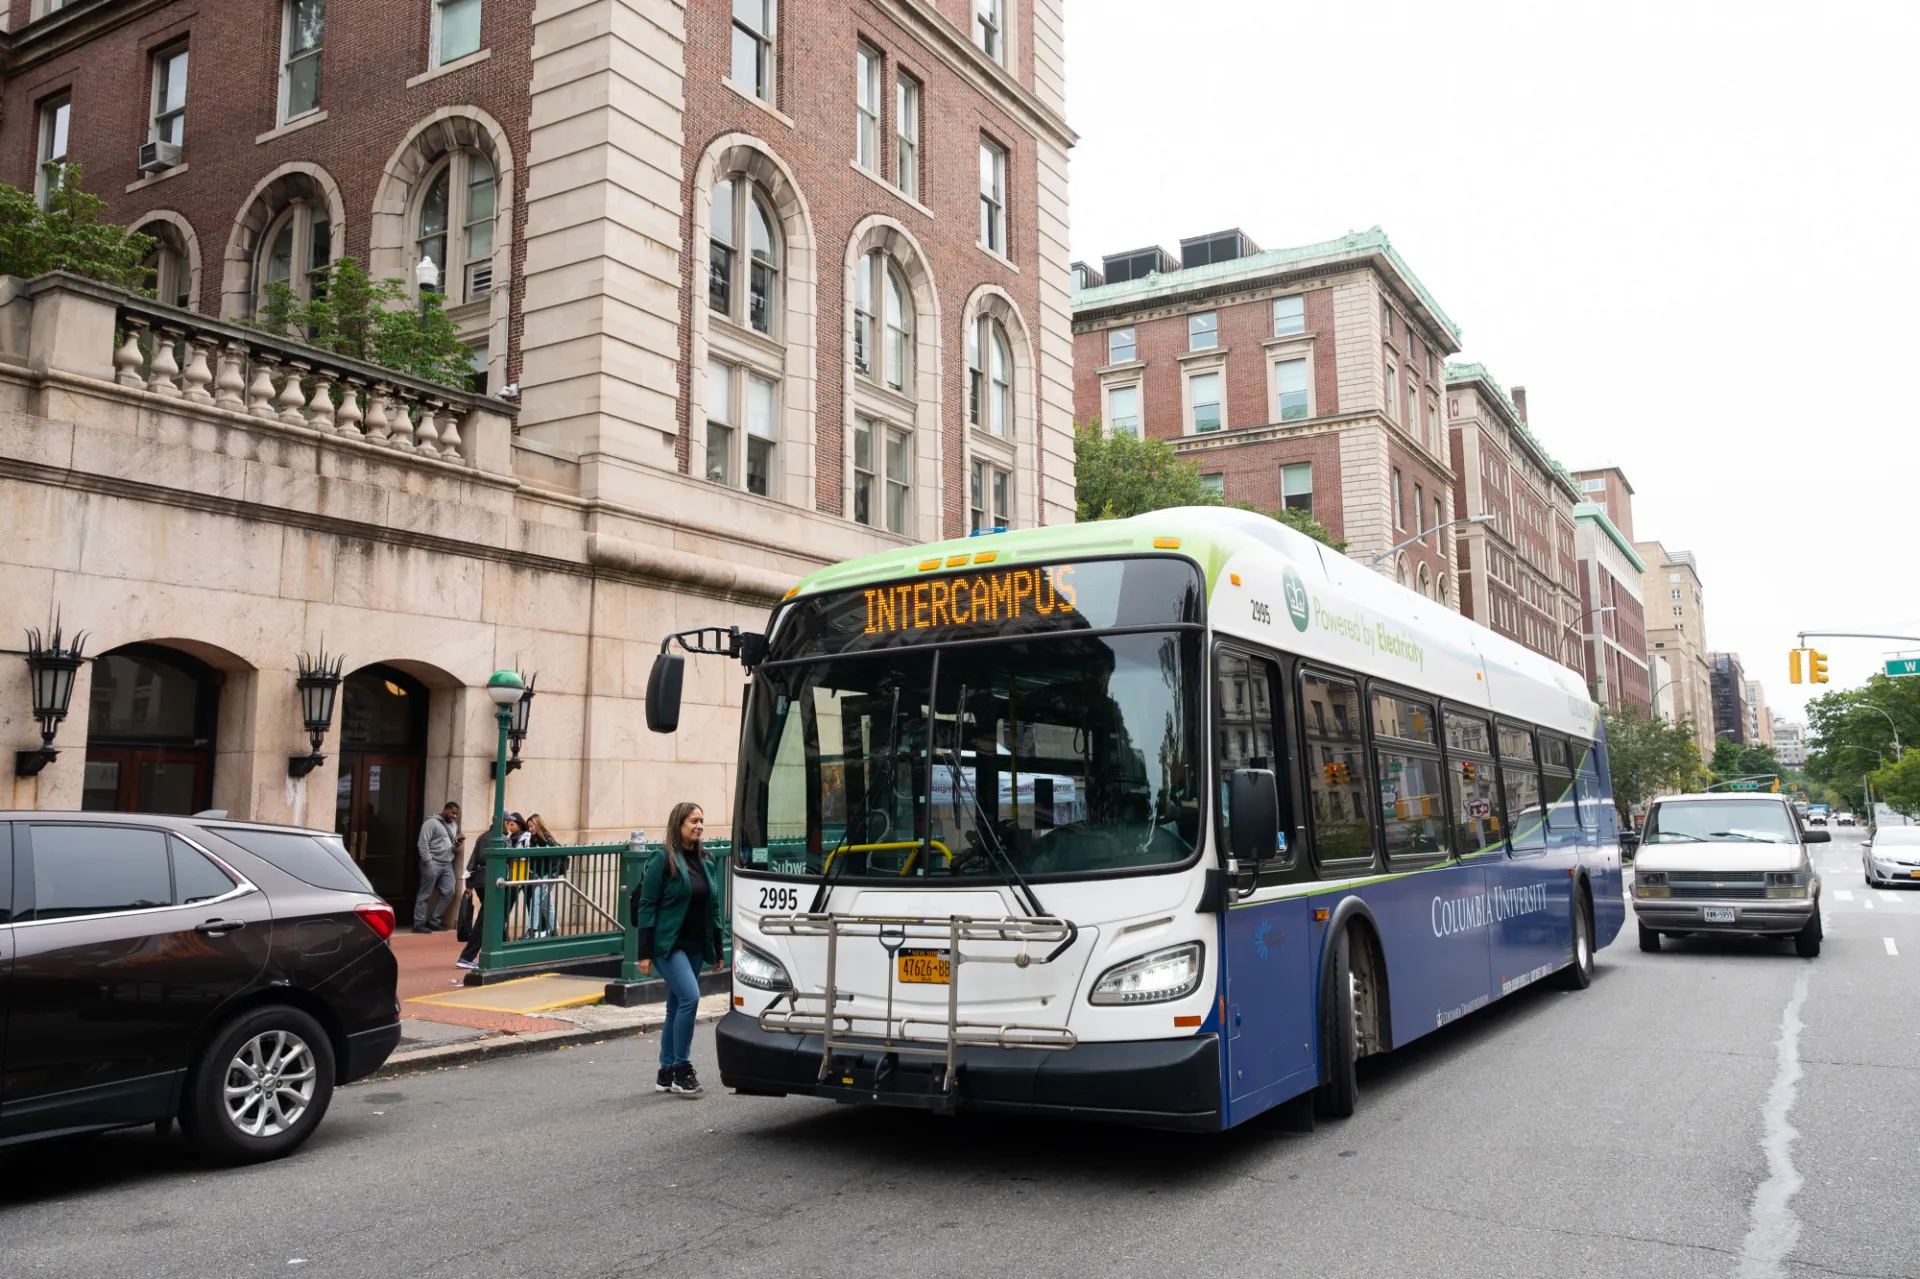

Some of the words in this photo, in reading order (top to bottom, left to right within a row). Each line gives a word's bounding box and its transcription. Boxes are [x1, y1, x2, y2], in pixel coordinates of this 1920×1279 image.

[864, 565, 1076, 634] INTERCAMPUS
[1250, 599, 1271, 625] 2995
[1312, 596, 1361, 642] Powered
[1362, 612, 1375, 656] by
[1376, 622, 1424, 672] Electricity
[1904, 661, 1916, 672] W
[759, 887, 798, 911] 2995
[1431, 896, 1494, 938] COLUMBIA
[1494, 882, 1547, 922] UNIVERSITY
